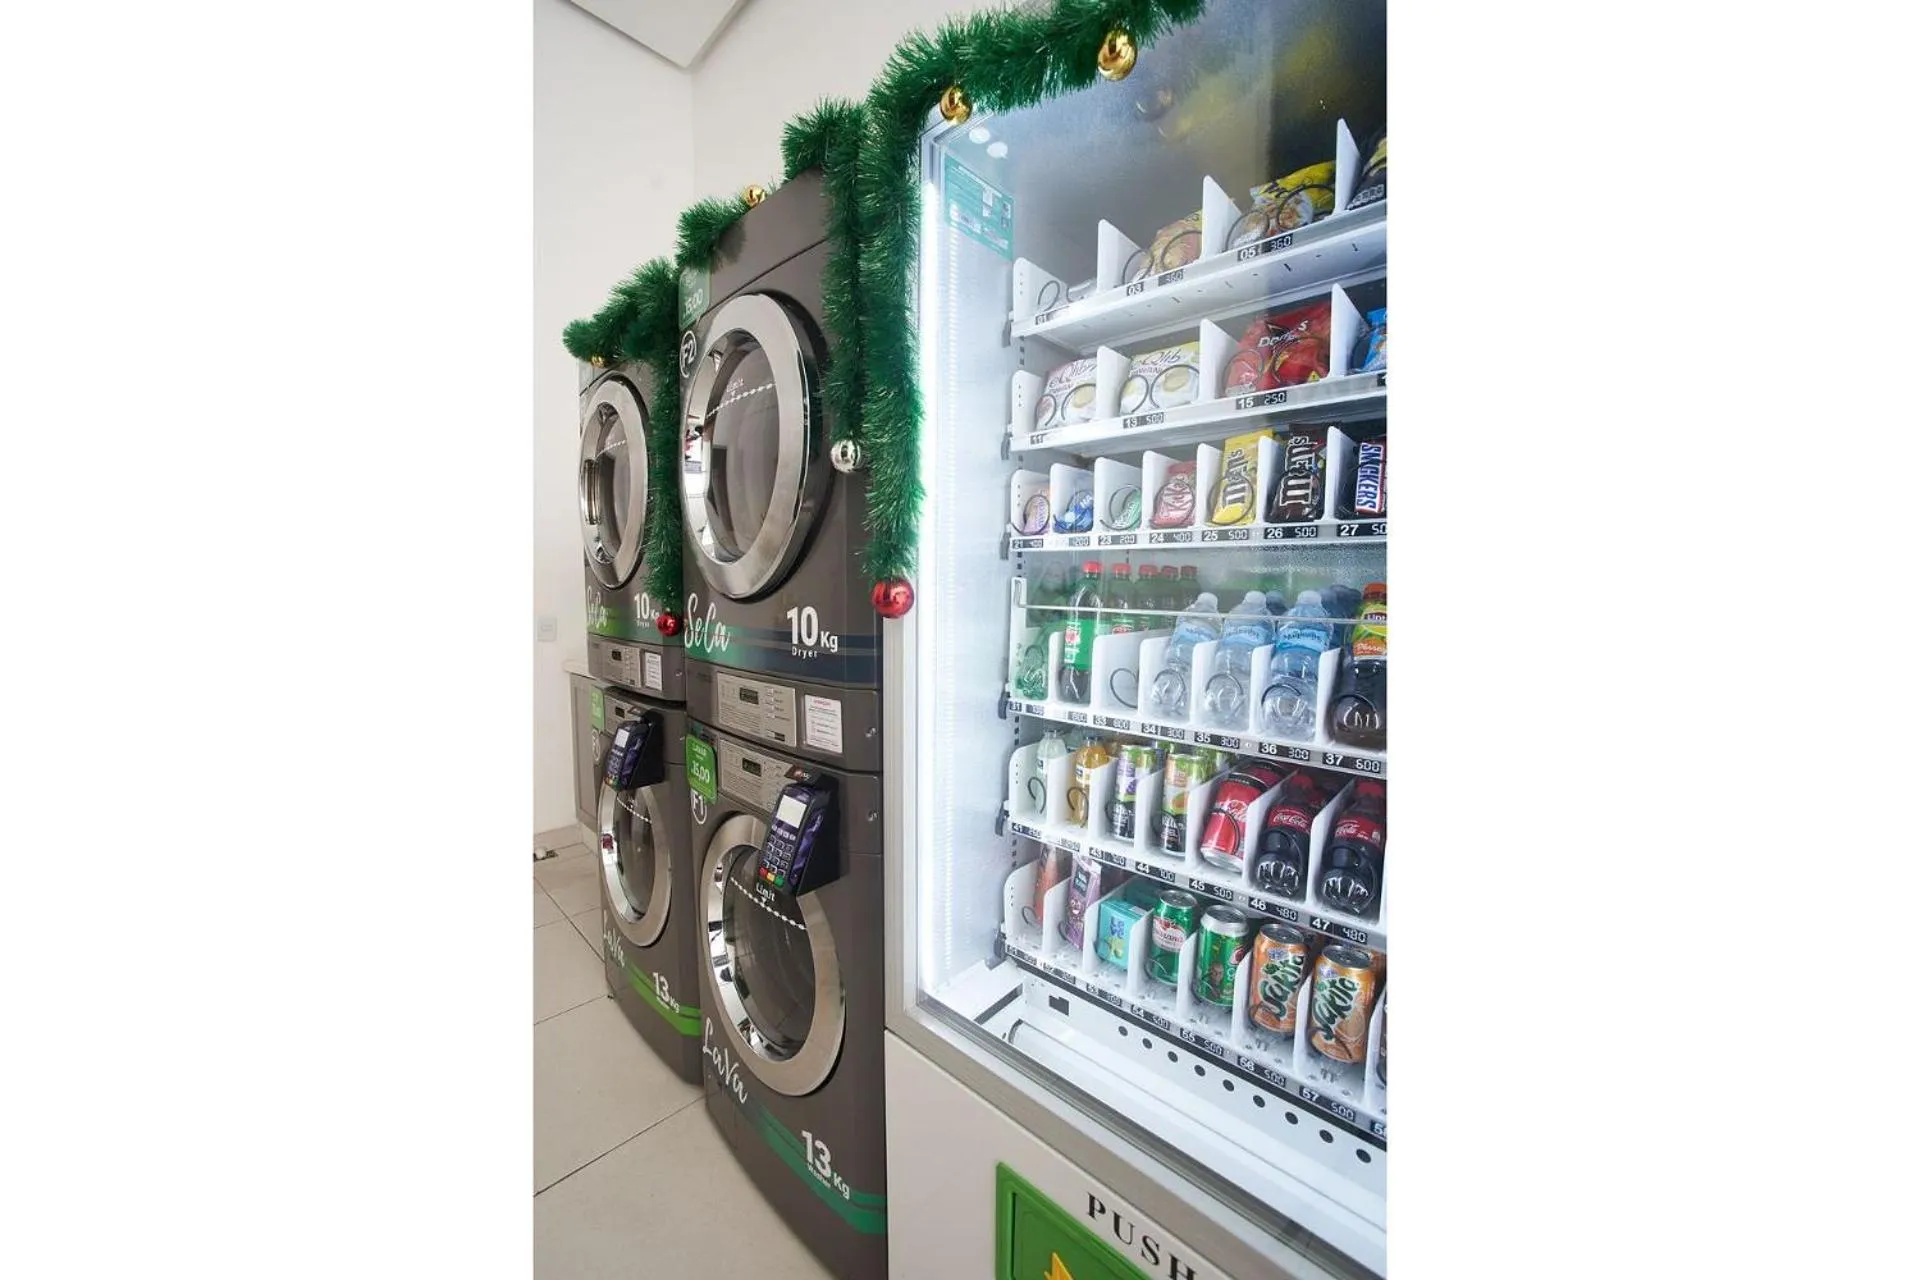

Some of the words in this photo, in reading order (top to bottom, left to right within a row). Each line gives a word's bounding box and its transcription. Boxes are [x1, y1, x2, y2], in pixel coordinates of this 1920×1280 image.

[1240, 249, 1256, 261] 05
[1238, 398, 1254, 409] 15
[1356, 442, 1382, 511] SNICKERS
[1151, 533, 1164, 542] 24
[1204, 530, 1218, 540] 25
[1228, 530, 1248, 540] 500
[1267, 528, 1283, 539] 26
[1294, 526, 1317, 538] 500
[1340, 524, 1359, 536] 27
[1372, 524, 1386, 535] 50
[634, 592, 650, 620] 10
[684, 592, 731, 653] SeCa
[786, 605, 819, 647] 10
[820, 631, 838, 653] Kg
[791, 646, 818, 659] Dryer
[1196, 732, 1211, 744] 35
[1261, 743, 1277, 755] 36
[1288, 746, 1309, 760] 300
[1325, 753, 1343, 766] 37
[1355, 758, 1380, 773] 600
[1191, 879, 1205, 891] 45
[1213, 887, 1233, 900] 500
[1250, 898, 1267, 911] 46
[1312, 918, 1331, 931] 47
[1342, 926, 1367, 943] 480
[652, 972, 670, 1002] 13
[703, 1017, 748, 1104] LaVa
[802, 1130, 832, 1178] 13
[833, 1172, 850, 1200] Kg
[1087, 1192, 1198, 1280] PUSH
